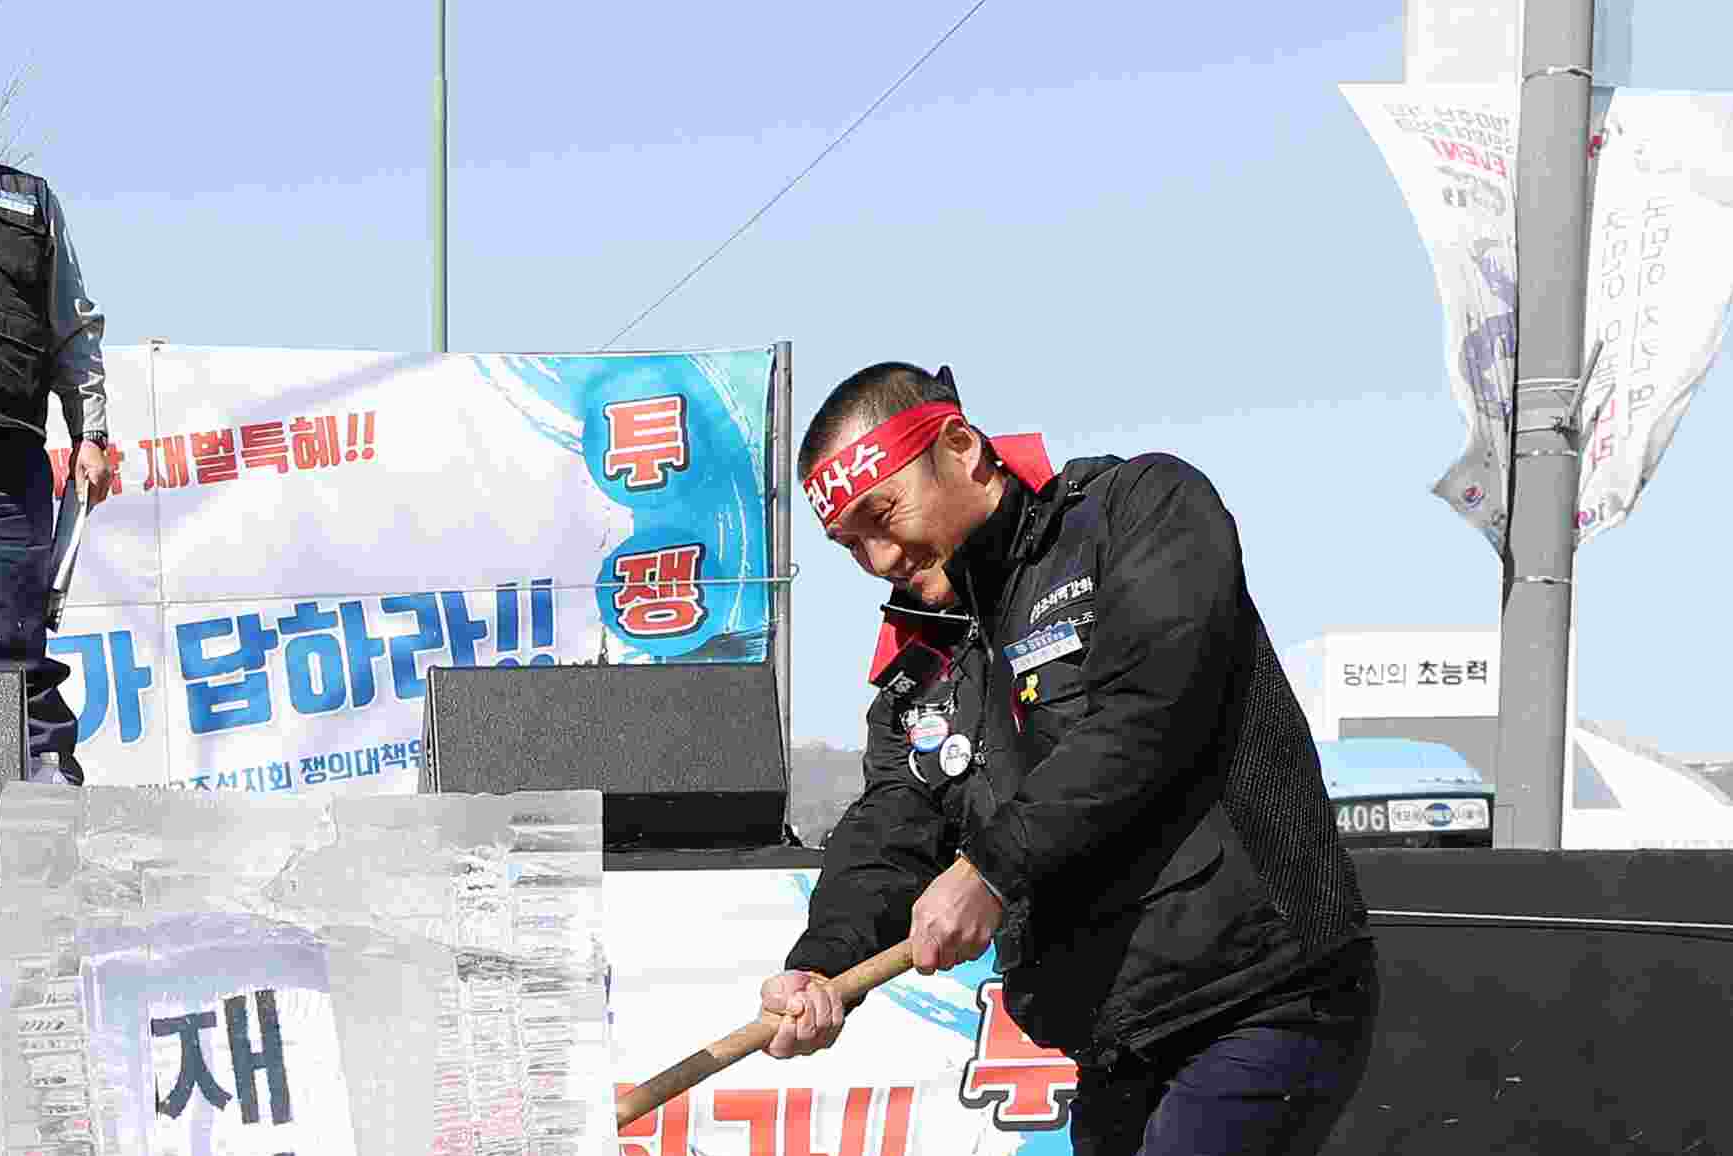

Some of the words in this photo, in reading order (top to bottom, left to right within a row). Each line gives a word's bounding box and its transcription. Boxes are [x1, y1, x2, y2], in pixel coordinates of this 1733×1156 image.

[138, 411, 378, 491] 재벌특혜!!
[175, 578, 560, 736] 답하라!!
[1343, 663, 1407, 687] 당신의
[1417, 660, 1489, 687] 초능력
[1337, 805, 1385, 831] 406
